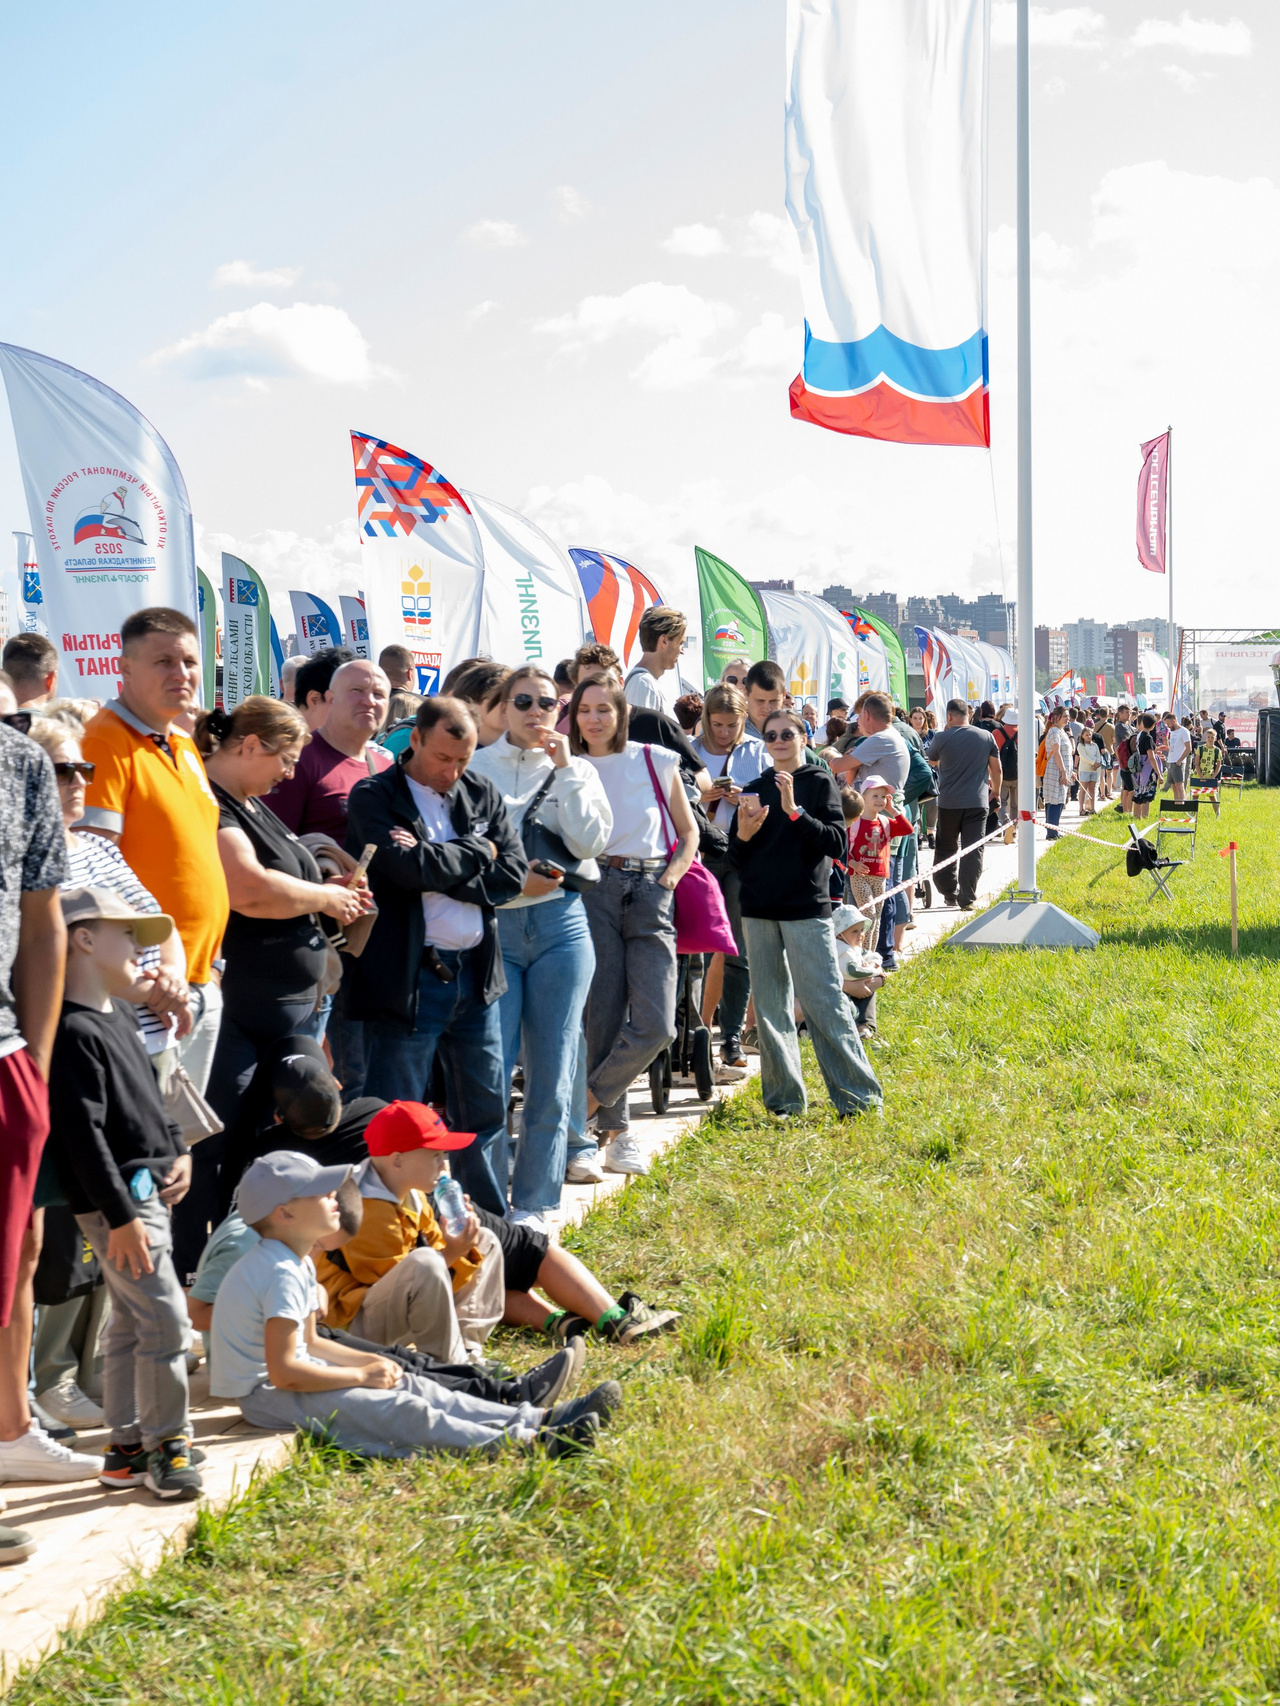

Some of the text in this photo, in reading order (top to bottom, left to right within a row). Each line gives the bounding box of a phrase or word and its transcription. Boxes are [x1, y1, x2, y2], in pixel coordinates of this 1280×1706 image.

[229, 619, 239, 668] ЛЕСАМИ
[242, 614, 254, 699] СКОЙ ОБЛАСТИ
